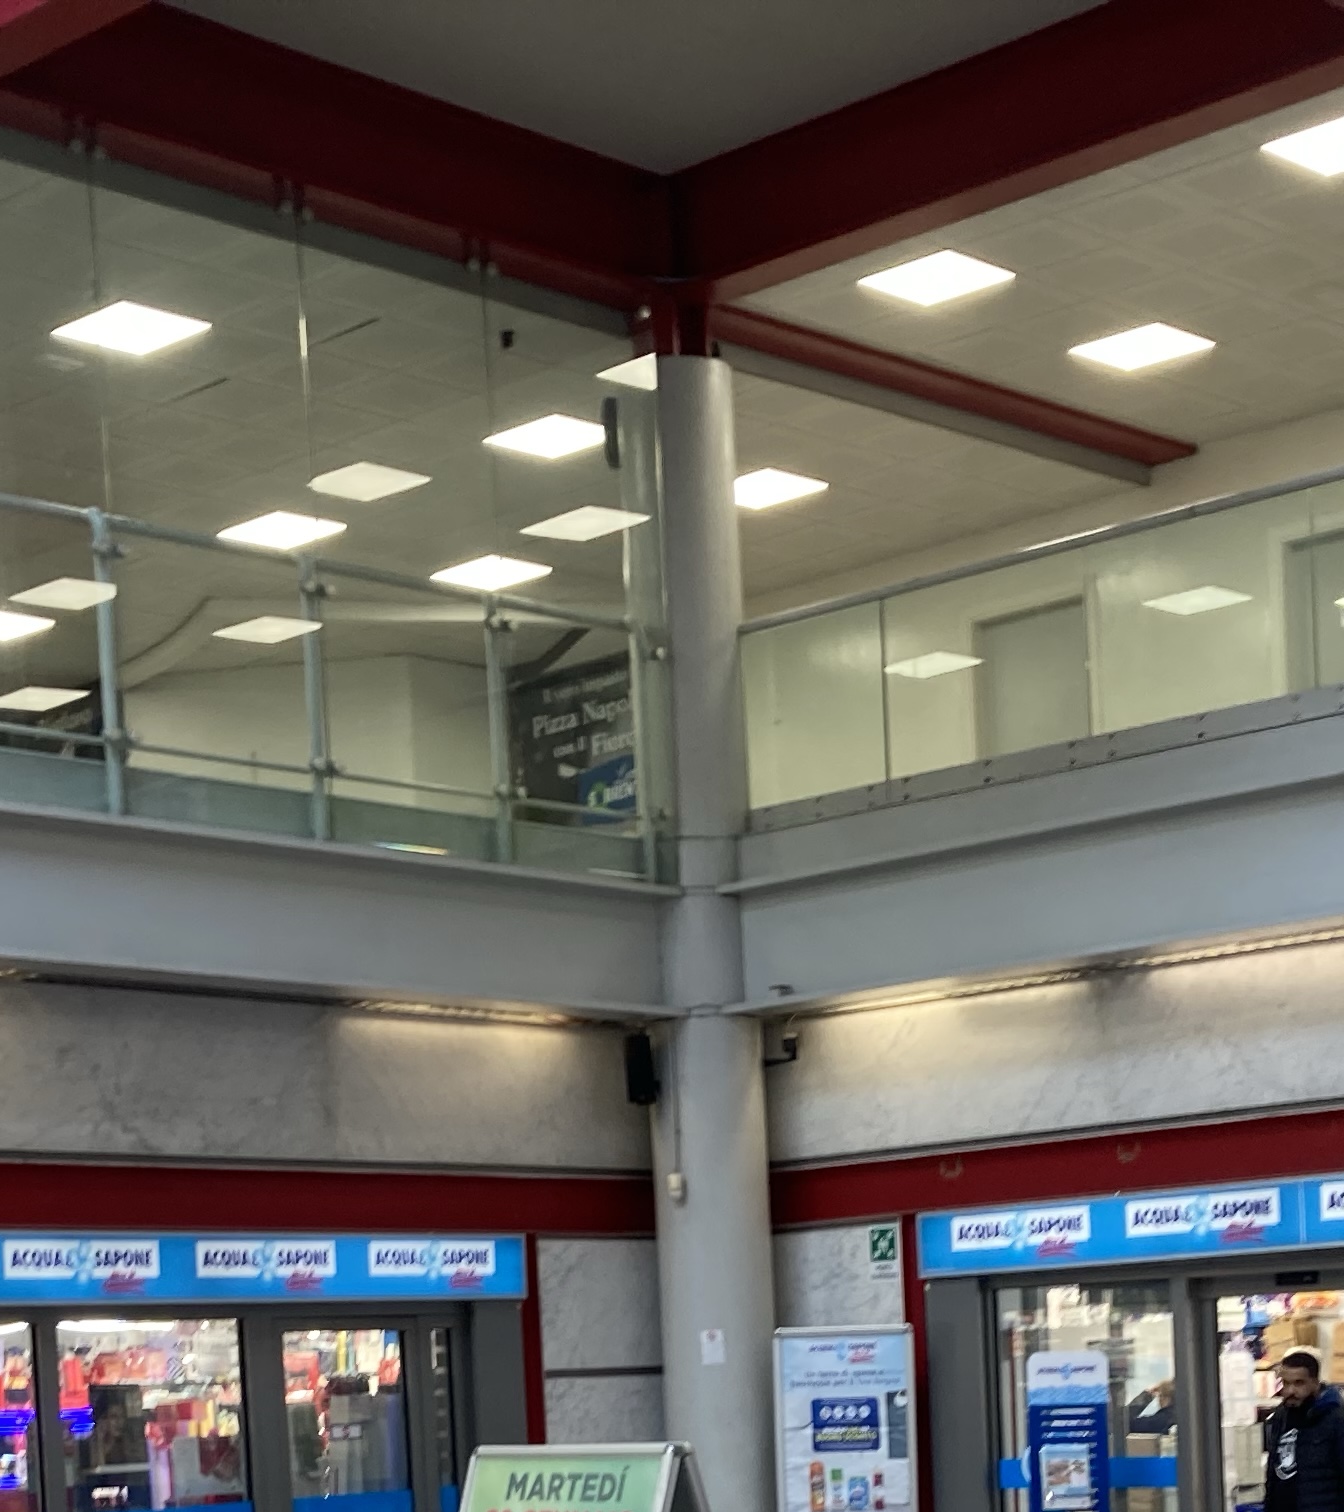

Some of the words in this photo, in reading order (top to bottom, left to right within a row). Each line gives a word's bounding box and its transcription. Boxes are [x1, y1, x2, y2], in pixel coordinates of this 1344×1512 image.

[532, 712, 580, 739] Pizza
[11, 1248, 63, 1269] ACQUA
[95, 1248, 153, 1267] SAPONE
[203, 1248, 250, 1269] ACQUA
[277, 1248, 330, 1267] SAPONE
[375, 1248, 417, 1269] ACQUA
[442, 1248, 490, 1266] SAPONE
